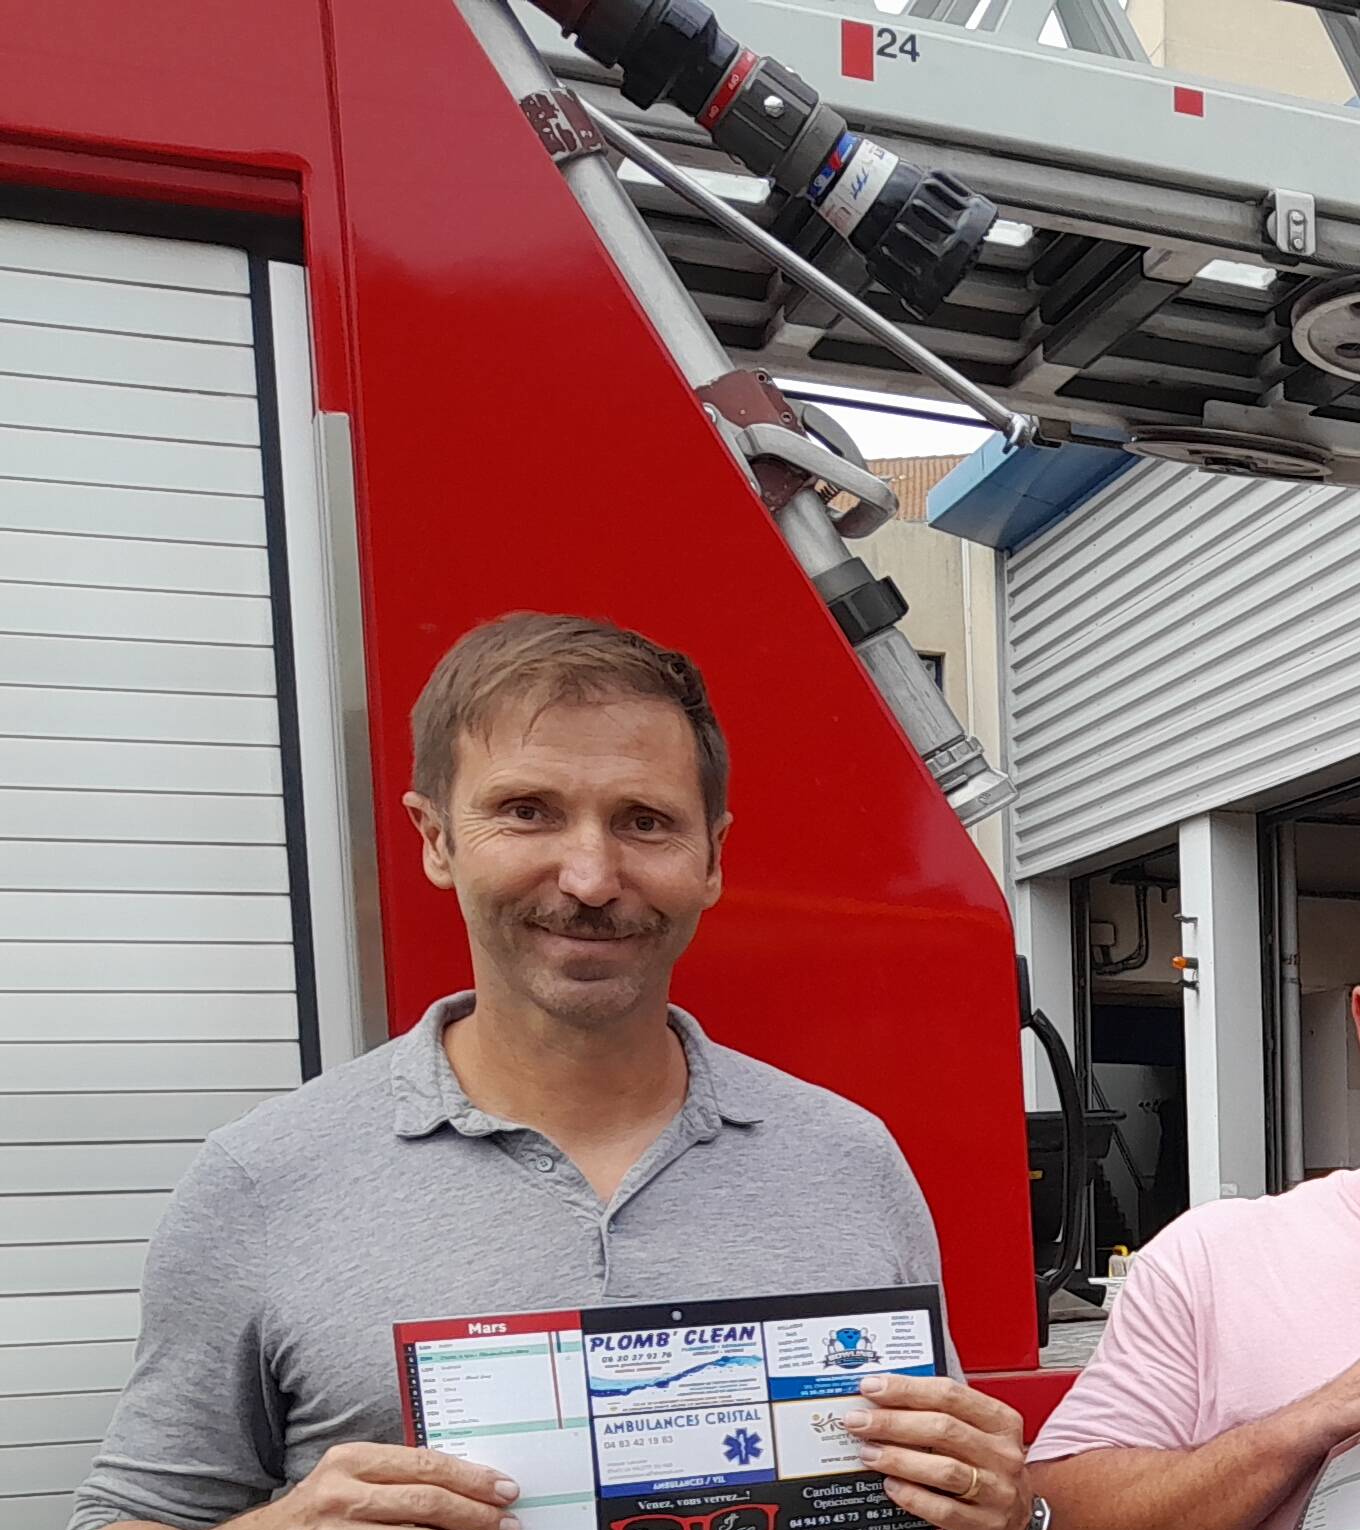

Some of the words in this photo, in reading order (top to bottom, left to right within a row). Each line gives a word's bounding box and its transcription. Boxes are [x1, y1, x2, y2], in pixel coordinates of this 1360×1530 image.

[877, 28, 920, 63] 24
[468, 1322, 507, 1335] Mars
[684, 1325, 756, 1346] CLEAN
[604, 1414, 700, 1435] AMBULANCES
[705, 1408, 761, 1425] CRISTAL
[802, 1482, 853, 1498] Caroline
